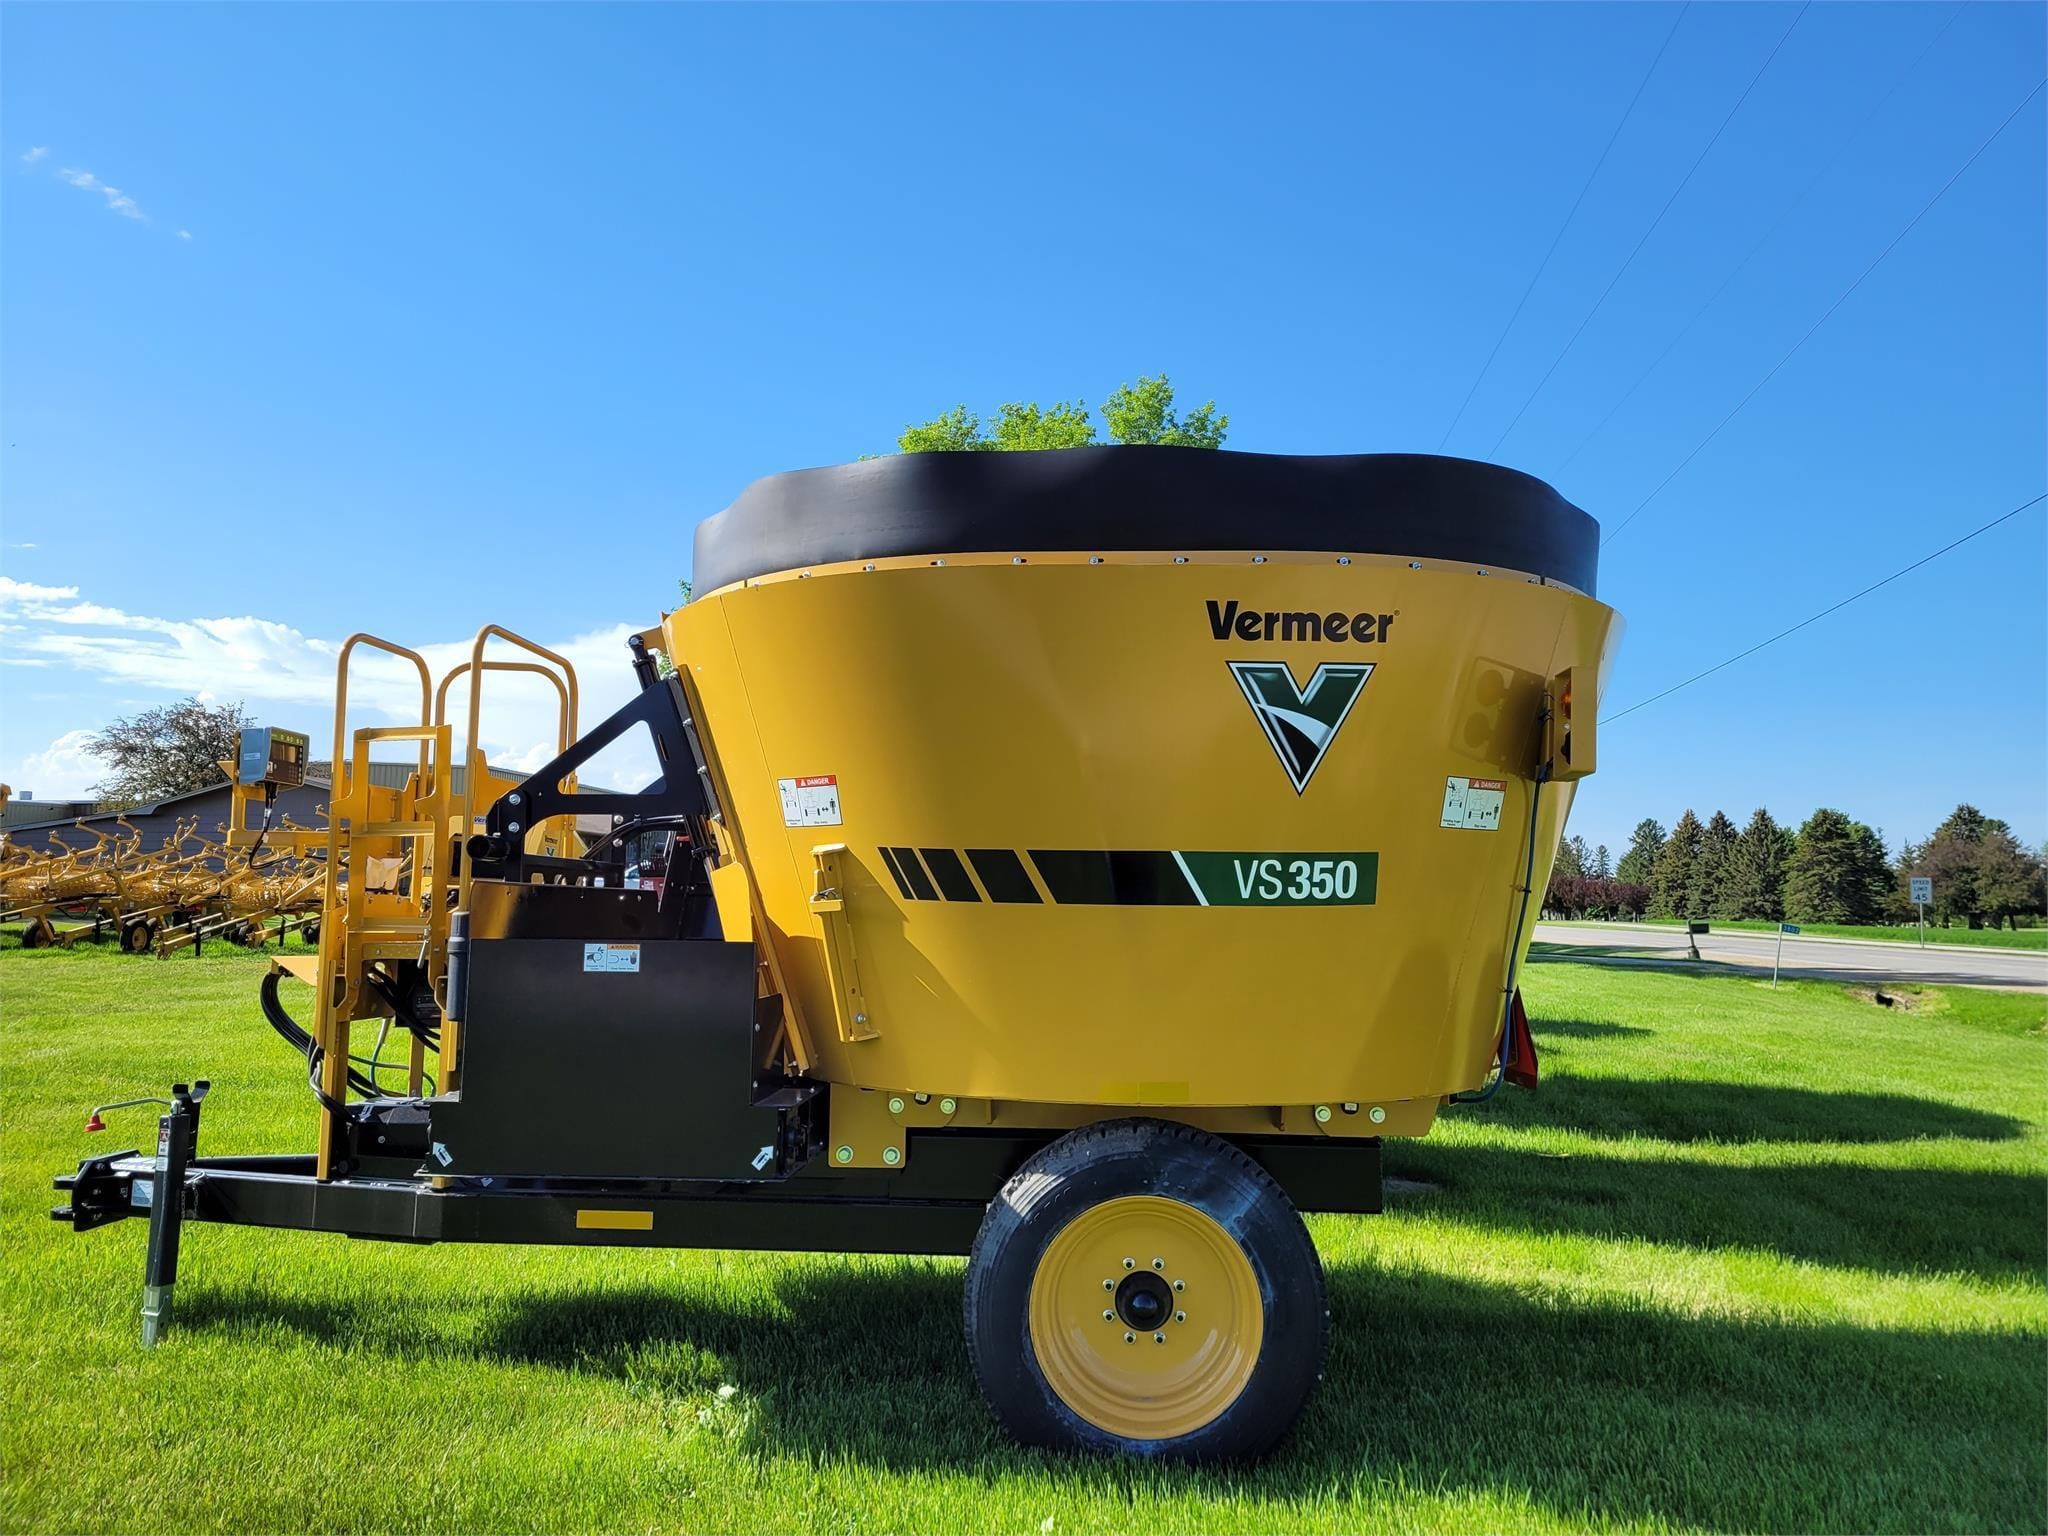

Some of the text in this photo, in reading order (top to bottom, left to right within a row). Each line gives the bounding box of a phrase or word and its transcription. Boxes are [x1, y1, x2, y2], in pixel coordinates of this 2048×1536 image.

[1206, 600, 1393, 643] Vermeer
[807, 777, 829, 786] DANGER
[1914, 893, 1928, 901] 45
